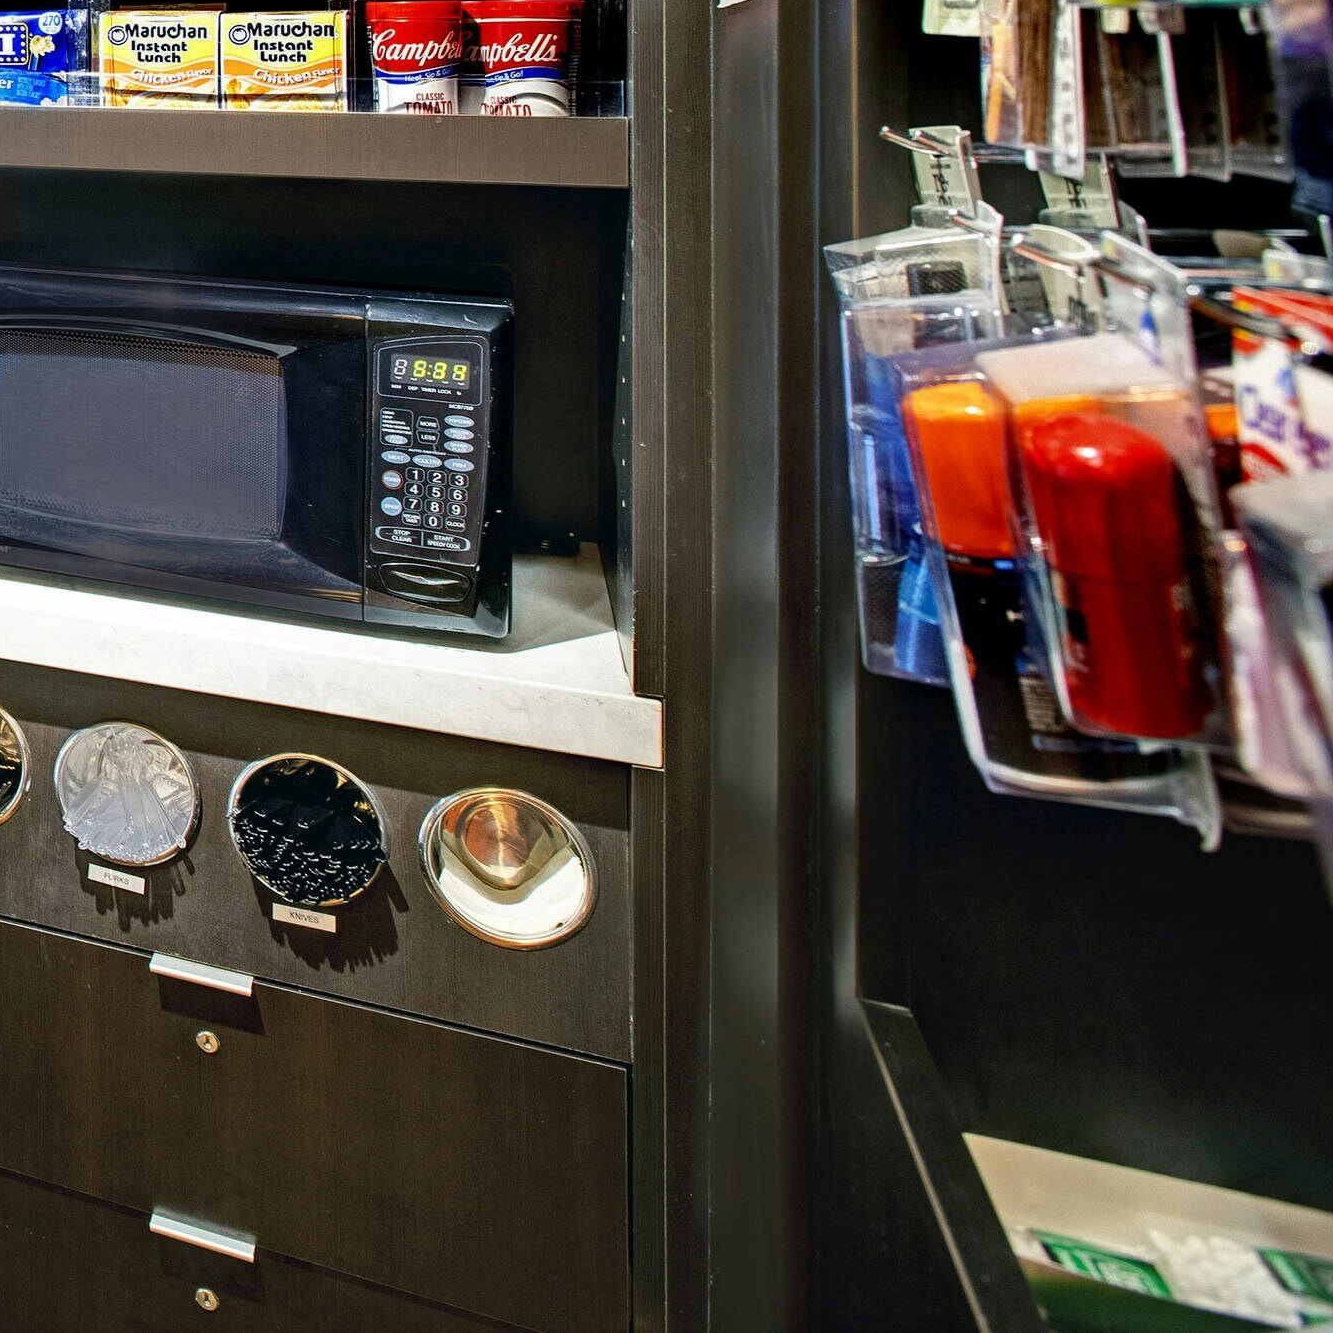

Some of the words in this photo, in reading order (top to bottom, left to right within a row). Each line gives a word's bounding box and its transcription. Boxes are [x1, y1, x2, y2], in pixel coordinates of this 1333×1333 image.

[42, 15, 60, 27] 270
[125, 22, 208, 39] Maruchan
[246, 22, 337, 38] Maruchan
[131, 40, 188, 53] Instant
[253, 39, 314, 52] Instant
[136, 51, 182, 64] Lunch
[259, 50, 307, 63] Lunch
[130, 69, 185, 85] Chicken
[186, 67, 213, 77] Flavor
[252, 68, 313, 86] Chicken
[314, 67, 341, 77] Flavor
[415, 92, 446, 102] CLASSIC
[490, 95, 518, 105] CLASSIC
[387, 454, 405, 462] MEAT
[414, 457, 440, 466] POULTRY
[412, 469, 418, 480] 1
[432, 472, 442, 484] 2
[454, 475, 465, 486] 3
[409, 484, 419, 495] 4
[431, 487, 441, 498] 5
[452, 489, 463, 501] 6
[408, 498, 418, 509] 7
[430, 501, 440, 513] 8
[451, 504, 461, 516] 9
[428, 516, 438, 527] 0
[391, 535, 413, 543] CLEAR
[433, 534, 455, 542] START
[103, 872, 130, 886] FORKS
[288, 911, 320, 924] KNIVES
